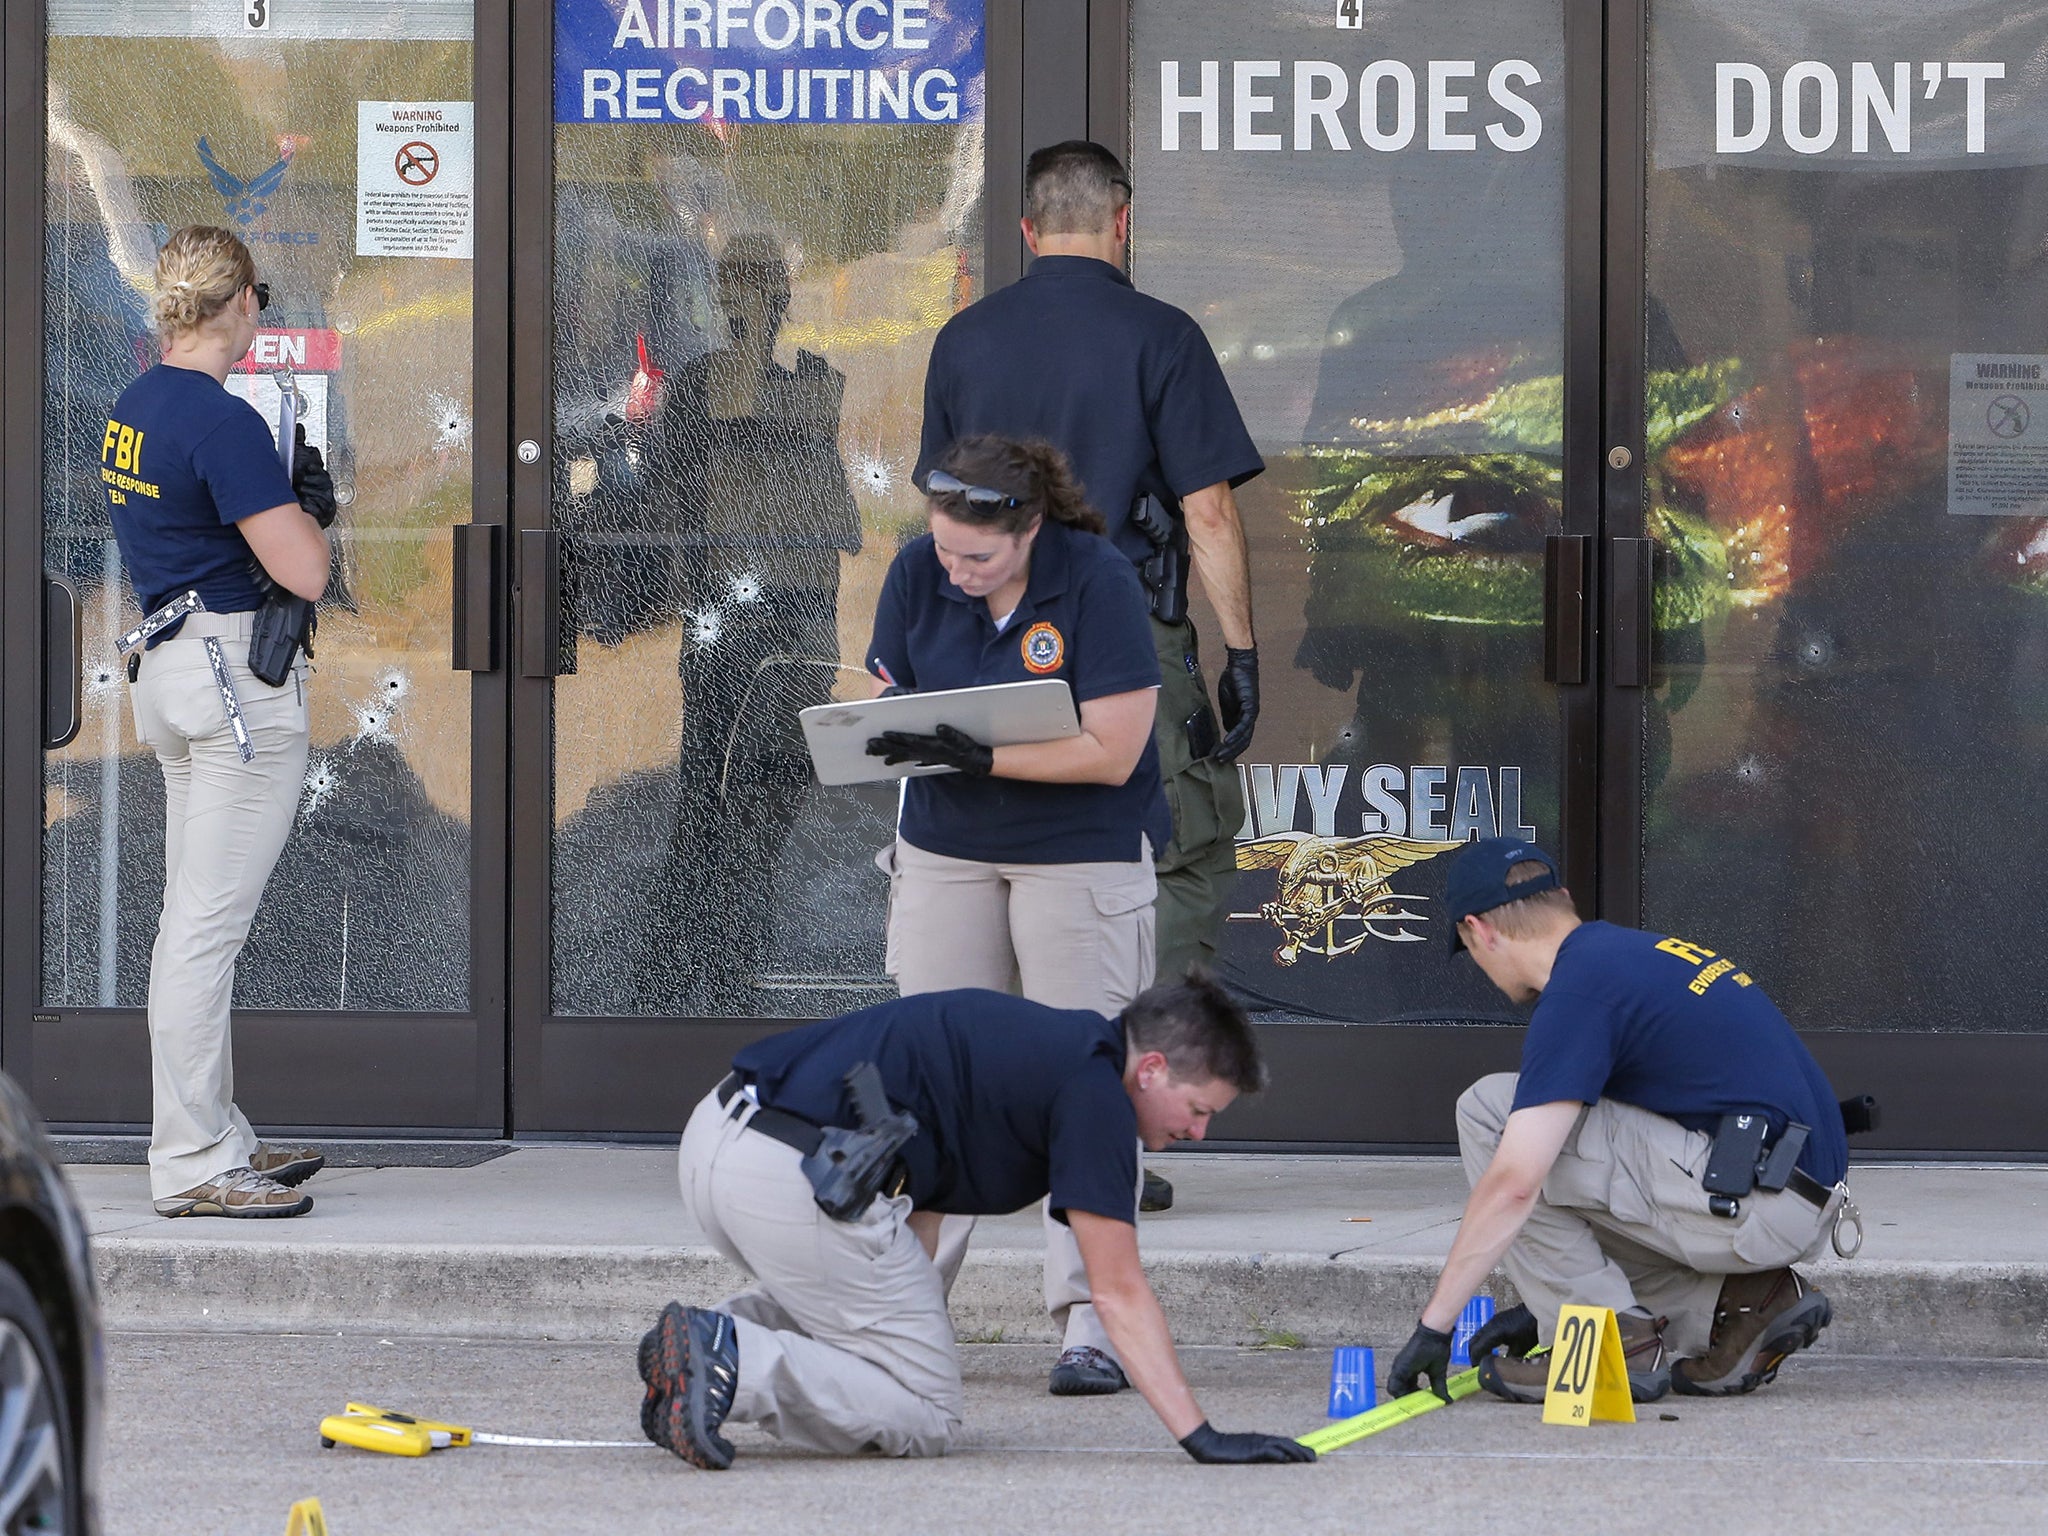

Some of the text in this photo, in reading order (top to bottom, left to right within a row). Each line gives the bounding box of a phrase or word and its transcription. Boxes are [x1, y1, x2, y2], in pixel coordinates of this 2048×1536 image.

[248, 0, 266, 28] 3
[612, 0, 931, 50] AIRFORCE
[1340, 0, 1359, 26] 4
[583, 67, 960, 121] RECRUITING
[1161, 59, 2006, 155] HEROES DON'T
[375, 123, 460, 134] Weapons Prohibited
[392, 110, 443, 121] WARNING
[249, 231, 319, 245] FORCE
[250, 334, 307, 365] EN
[1976, 363, 2042, 379] WARNING
[102, 419, 145, 475] FBI
[116, 473, 161, 499] RESPONSE
[1235, 763, 1536, 844] VY SEAL
[1553, 1315, 1597, 1395] 20
[1571, 1405, 1585, 1418] 20
